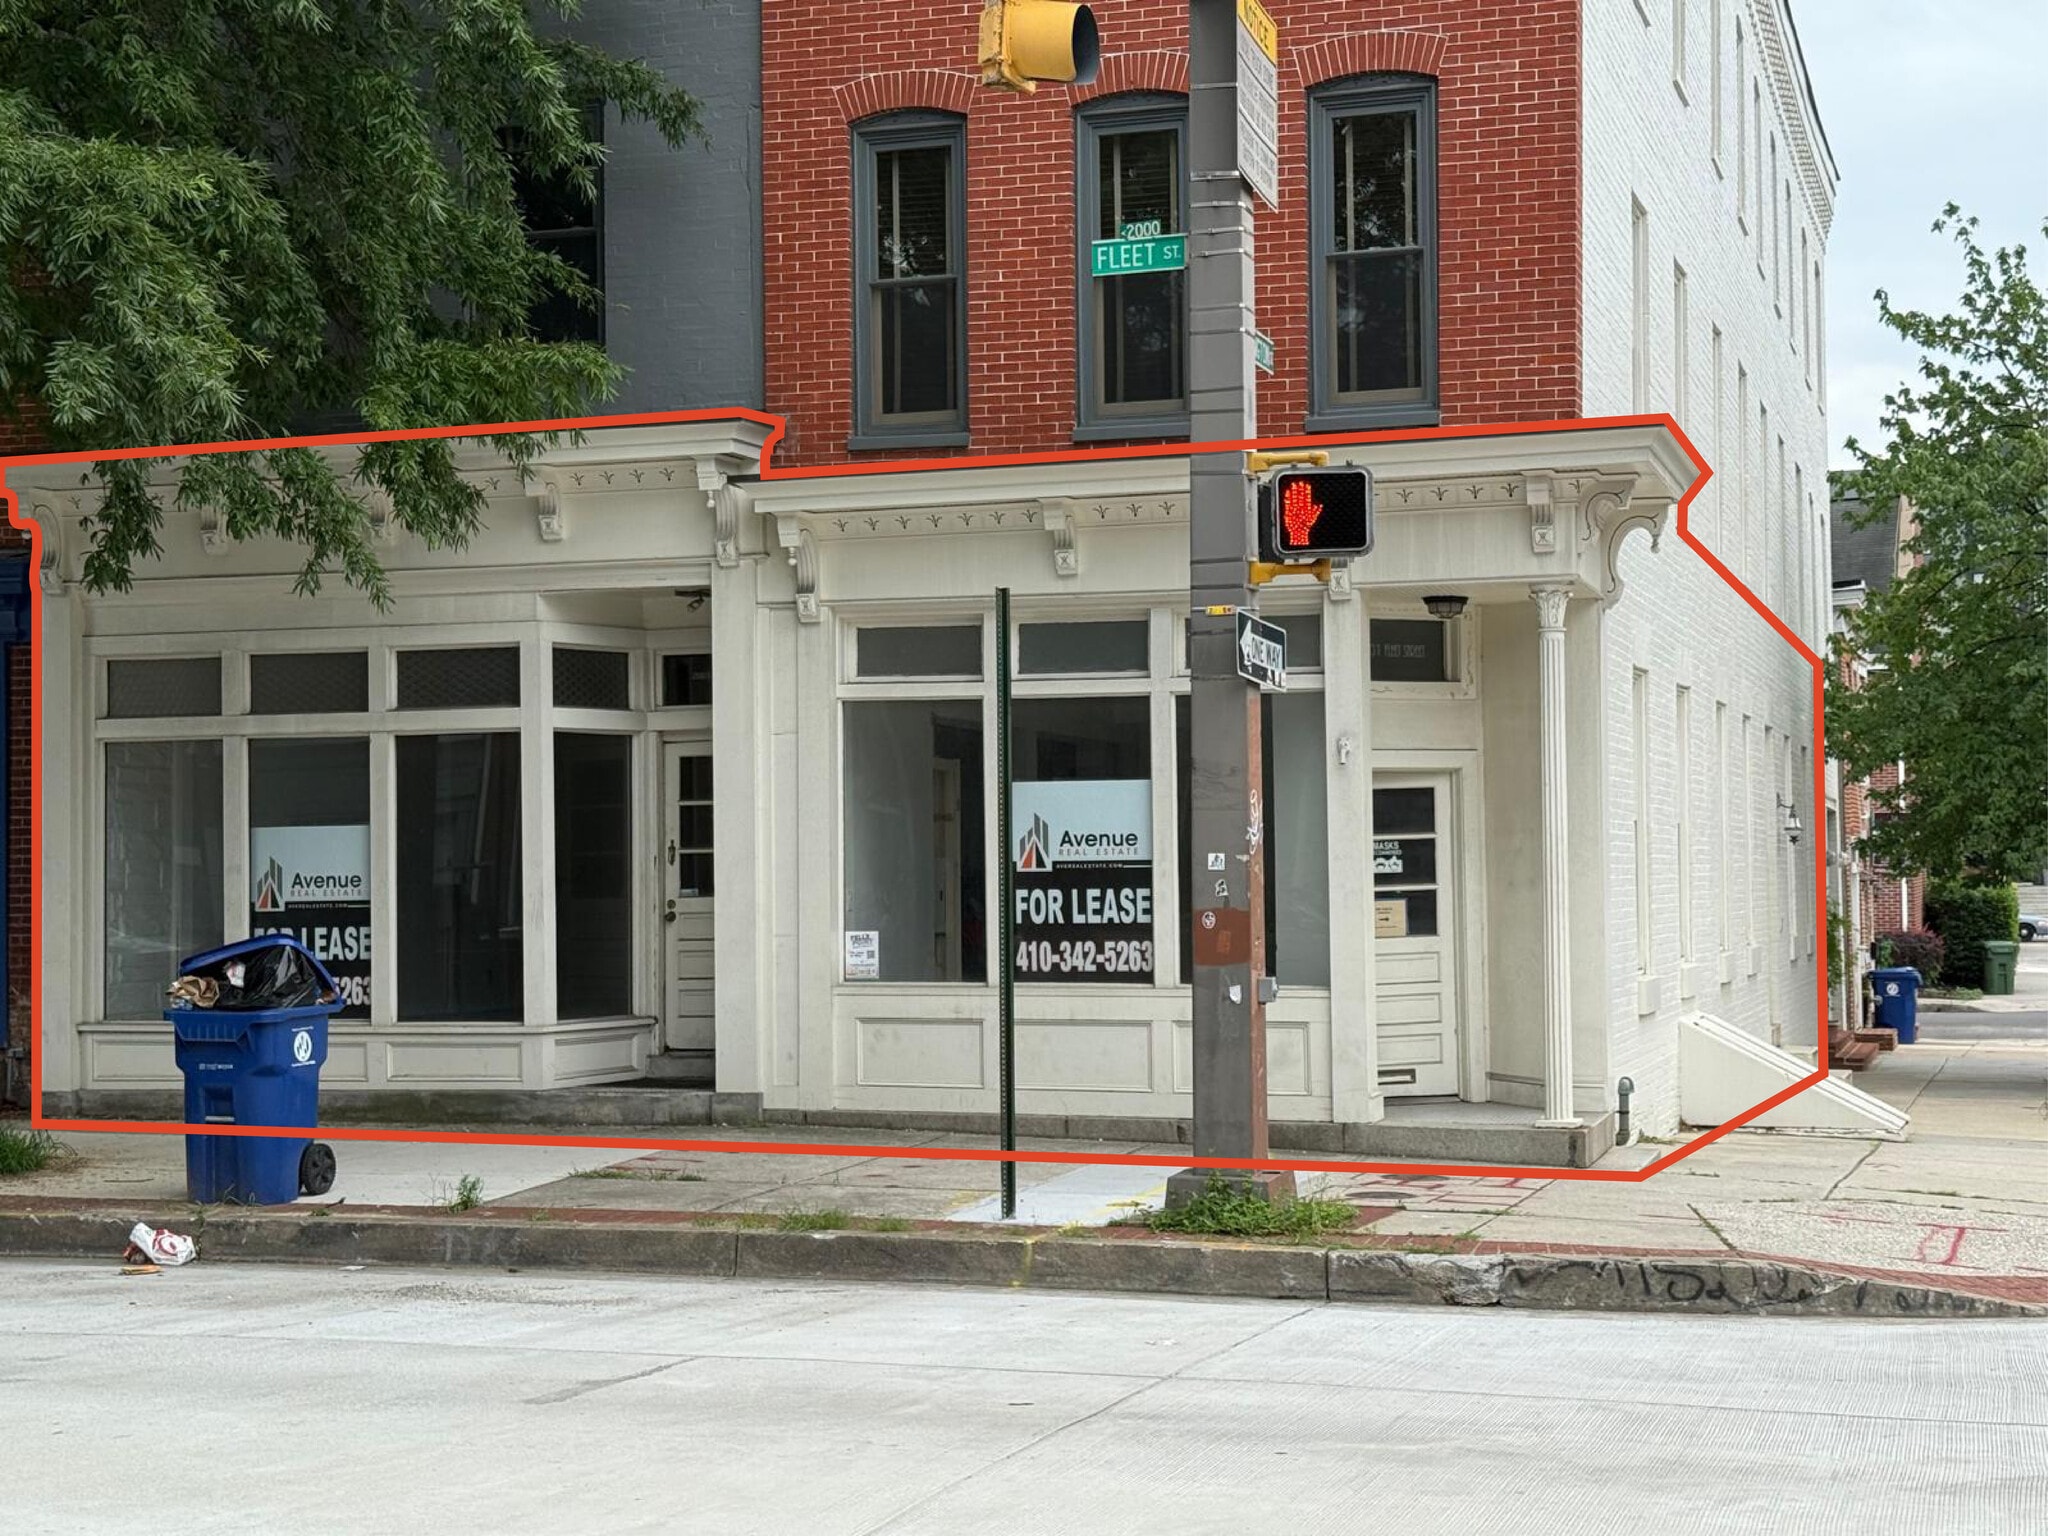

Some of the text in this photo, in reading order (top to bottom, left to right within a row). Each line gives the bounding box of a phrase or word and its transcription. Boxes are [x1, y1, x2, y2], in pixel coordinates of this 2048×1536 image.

[1126, 220, 1161, 241] 2000
[1097, 243, 1156, 270] FLEET
[1060, 830, 1138, 847] Avenue
[1058, 848, 1138, 856] REAL ESTATE
[291, 872, 362, 889] Avenue
[290, 889, 316, 897] REAL
[1015, 887, 1152, 924] FOR LEASE
[1015, 940, 1153, 973] 410-342-5263
